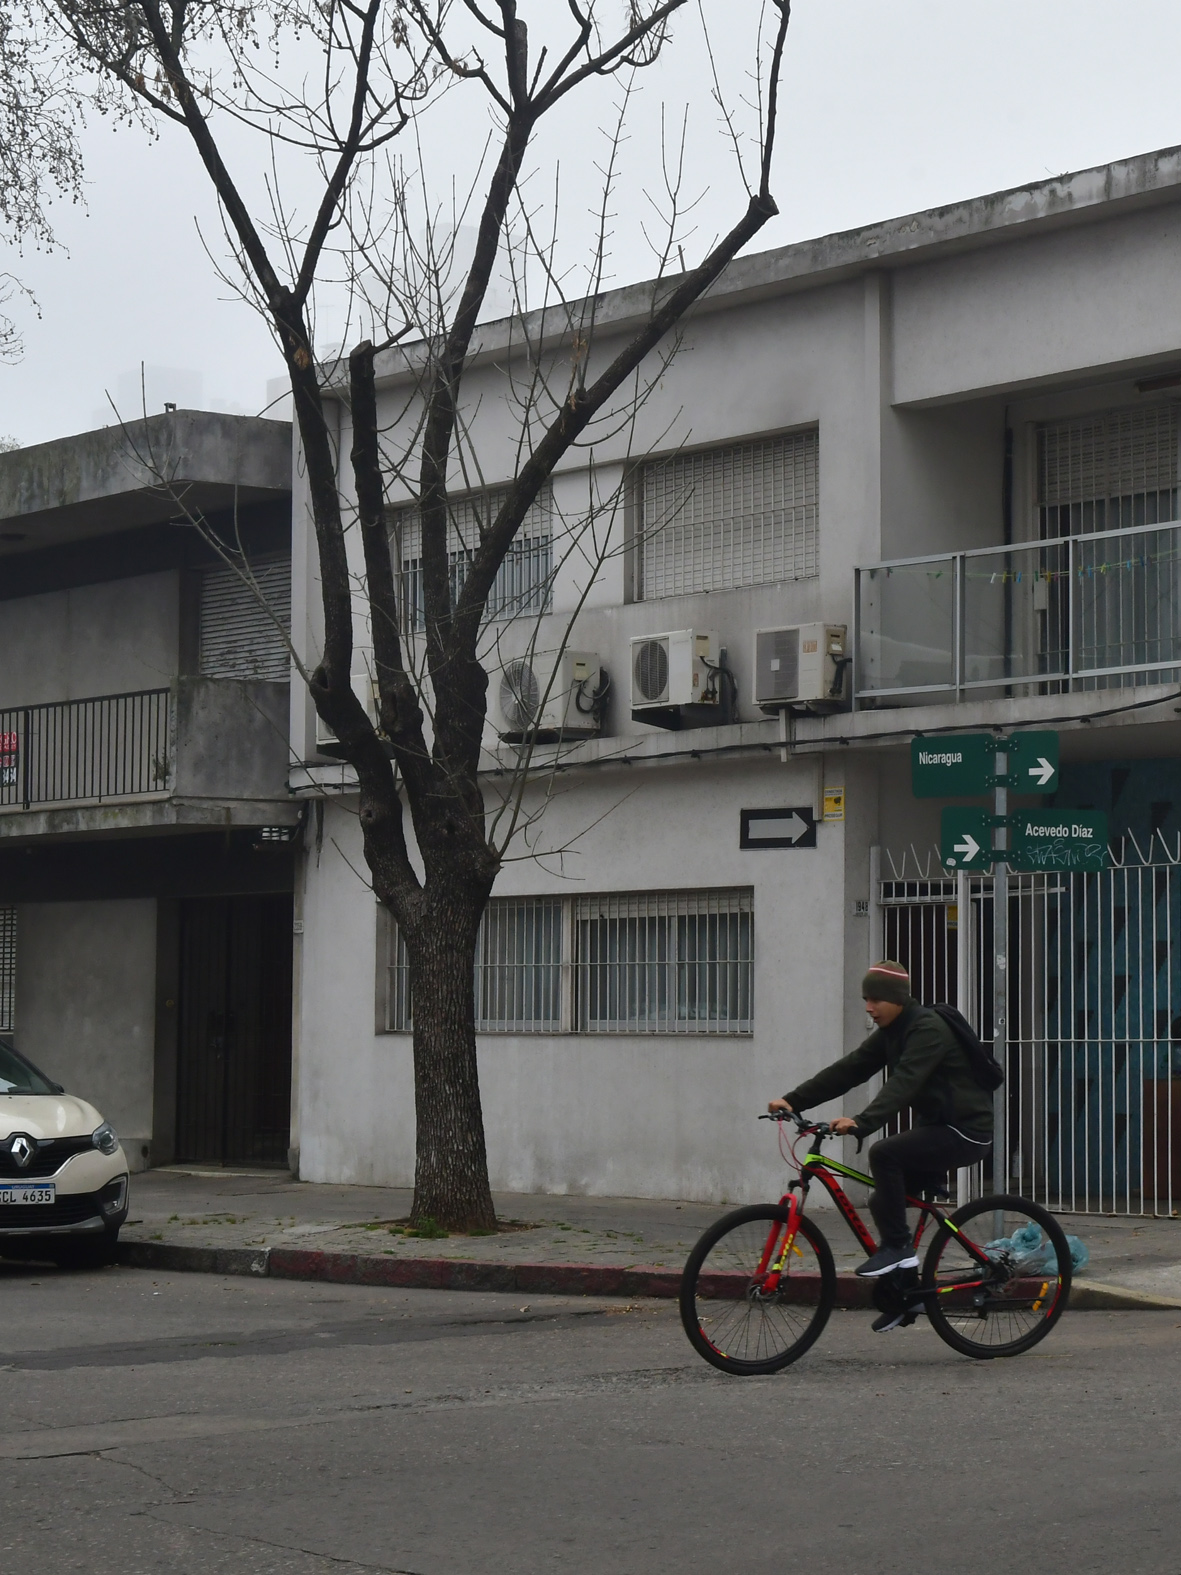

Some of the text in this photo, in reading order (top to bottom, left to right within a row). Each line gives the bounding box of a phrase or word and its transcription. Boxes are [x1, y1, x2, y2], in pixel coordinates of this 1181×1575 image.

[918, 751, 963, 767] Nicaragua
[1025, 822, 1094, 839] Acevedo Díaz
[855, 901, 869, 912] 1948
[0, 1189, 52, 1203] CL 4635
